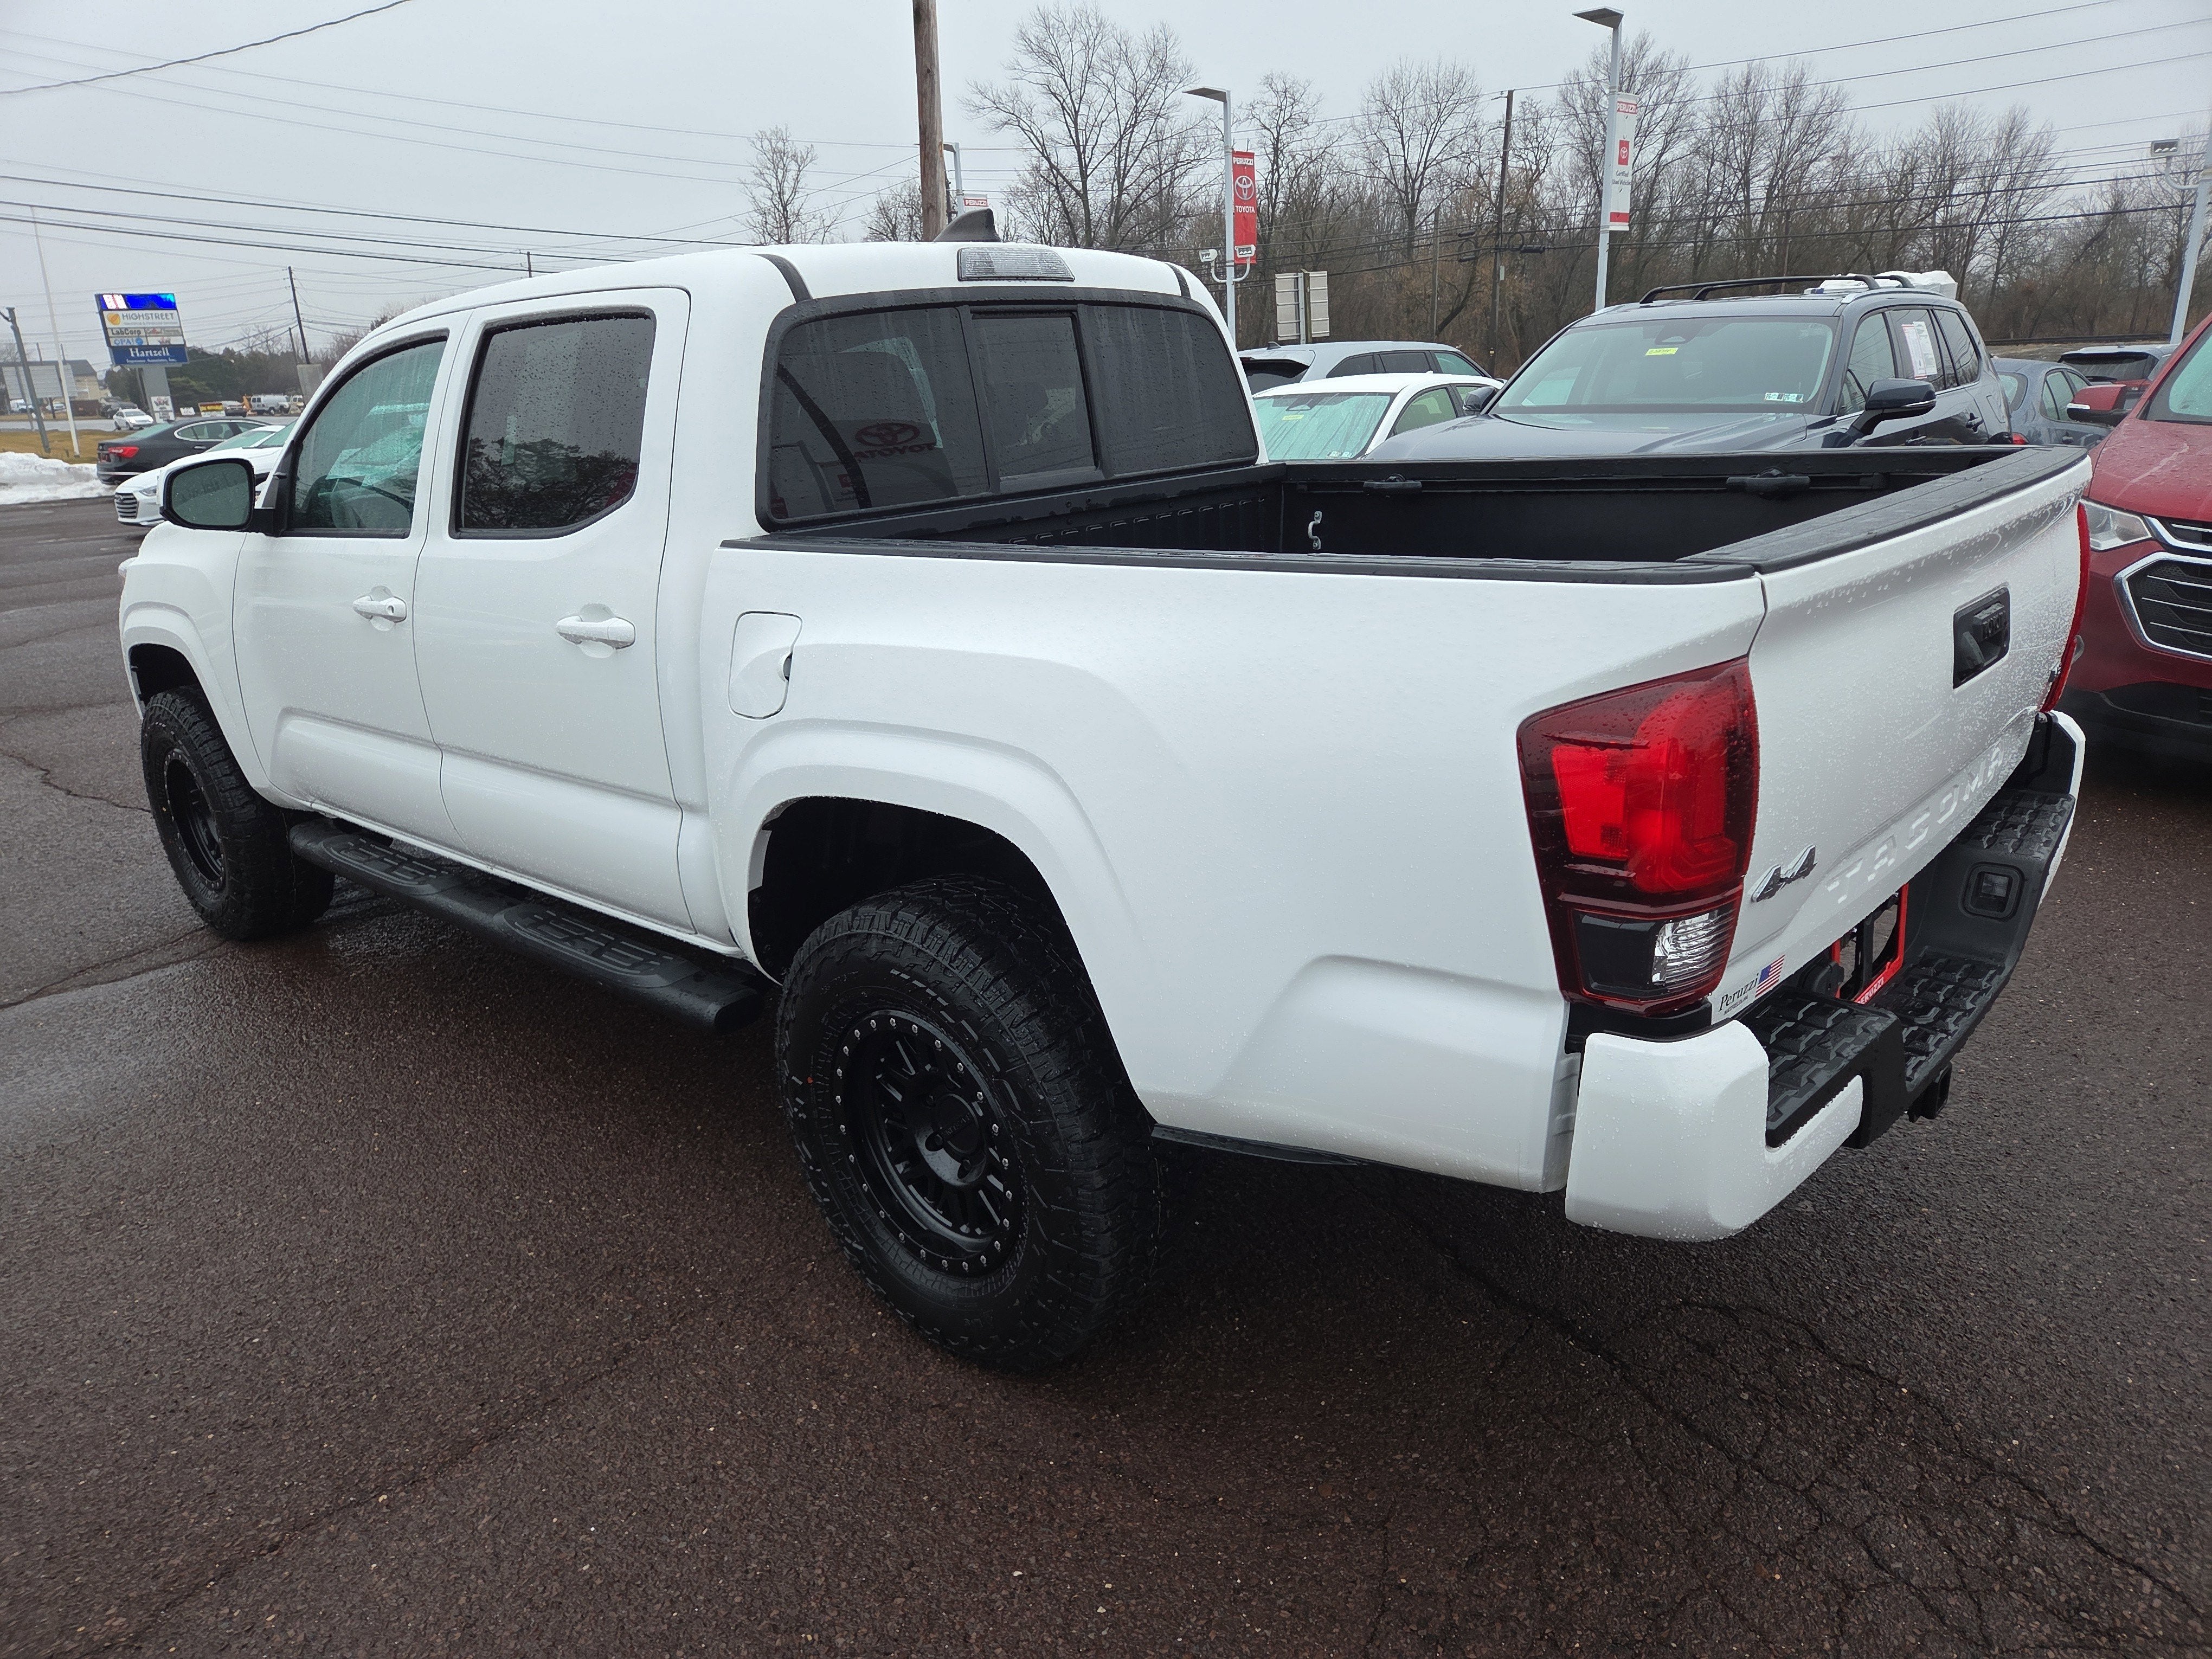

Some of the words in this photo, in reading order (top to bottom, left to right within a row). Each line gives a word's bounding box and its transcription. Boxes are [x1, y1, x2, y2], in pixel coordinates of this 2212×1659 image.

[1233, 157, 1253, 165] PERUZZI
[1236, 205, 1255, 214] TOYOTA
[111, 328, 142, 336] LabCorp
[129, 347, 170, 357] Hartzell
[1718, 973, 1759, 1012] Peruzzi
